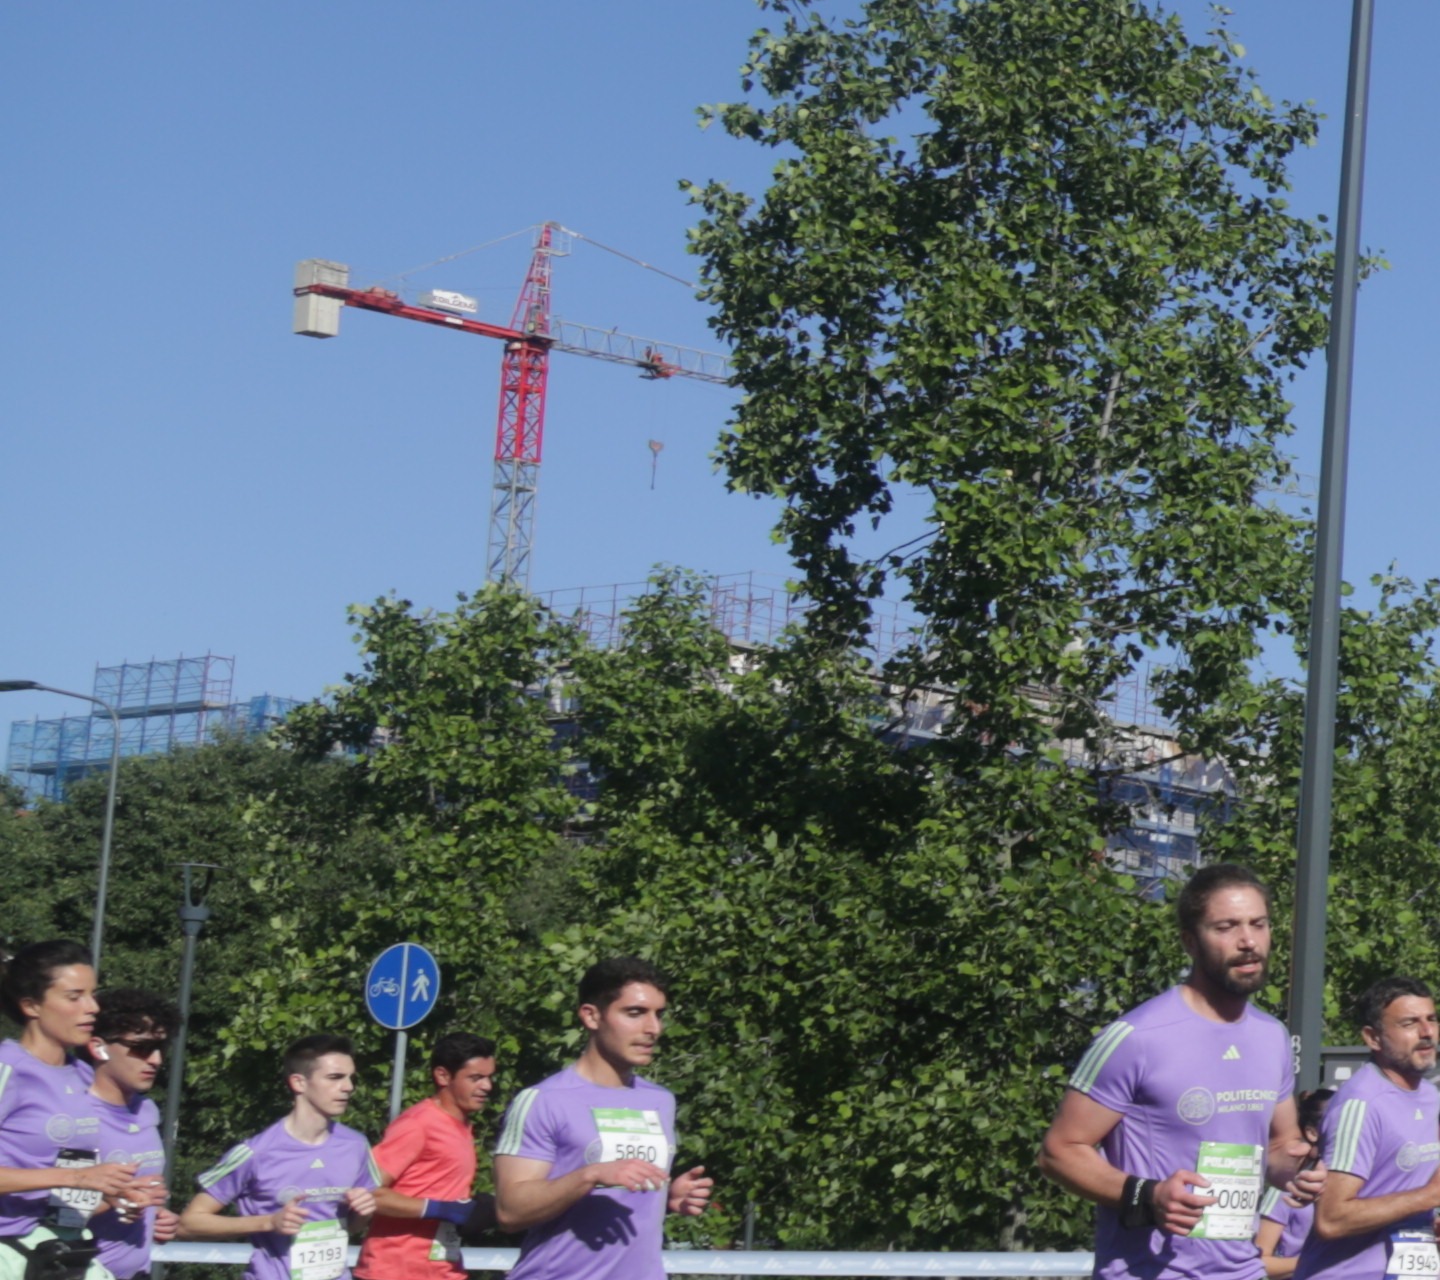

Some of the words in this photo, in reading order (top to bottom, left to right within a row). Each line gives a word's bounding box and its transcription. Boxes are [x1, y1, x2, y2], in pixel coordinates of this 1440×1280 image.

[1216, 1089, 1279, 1102] POLITECNICO
[1206, 1188, 1256, 1210] 10080
[299, 1246, 342, 1264] 12193
